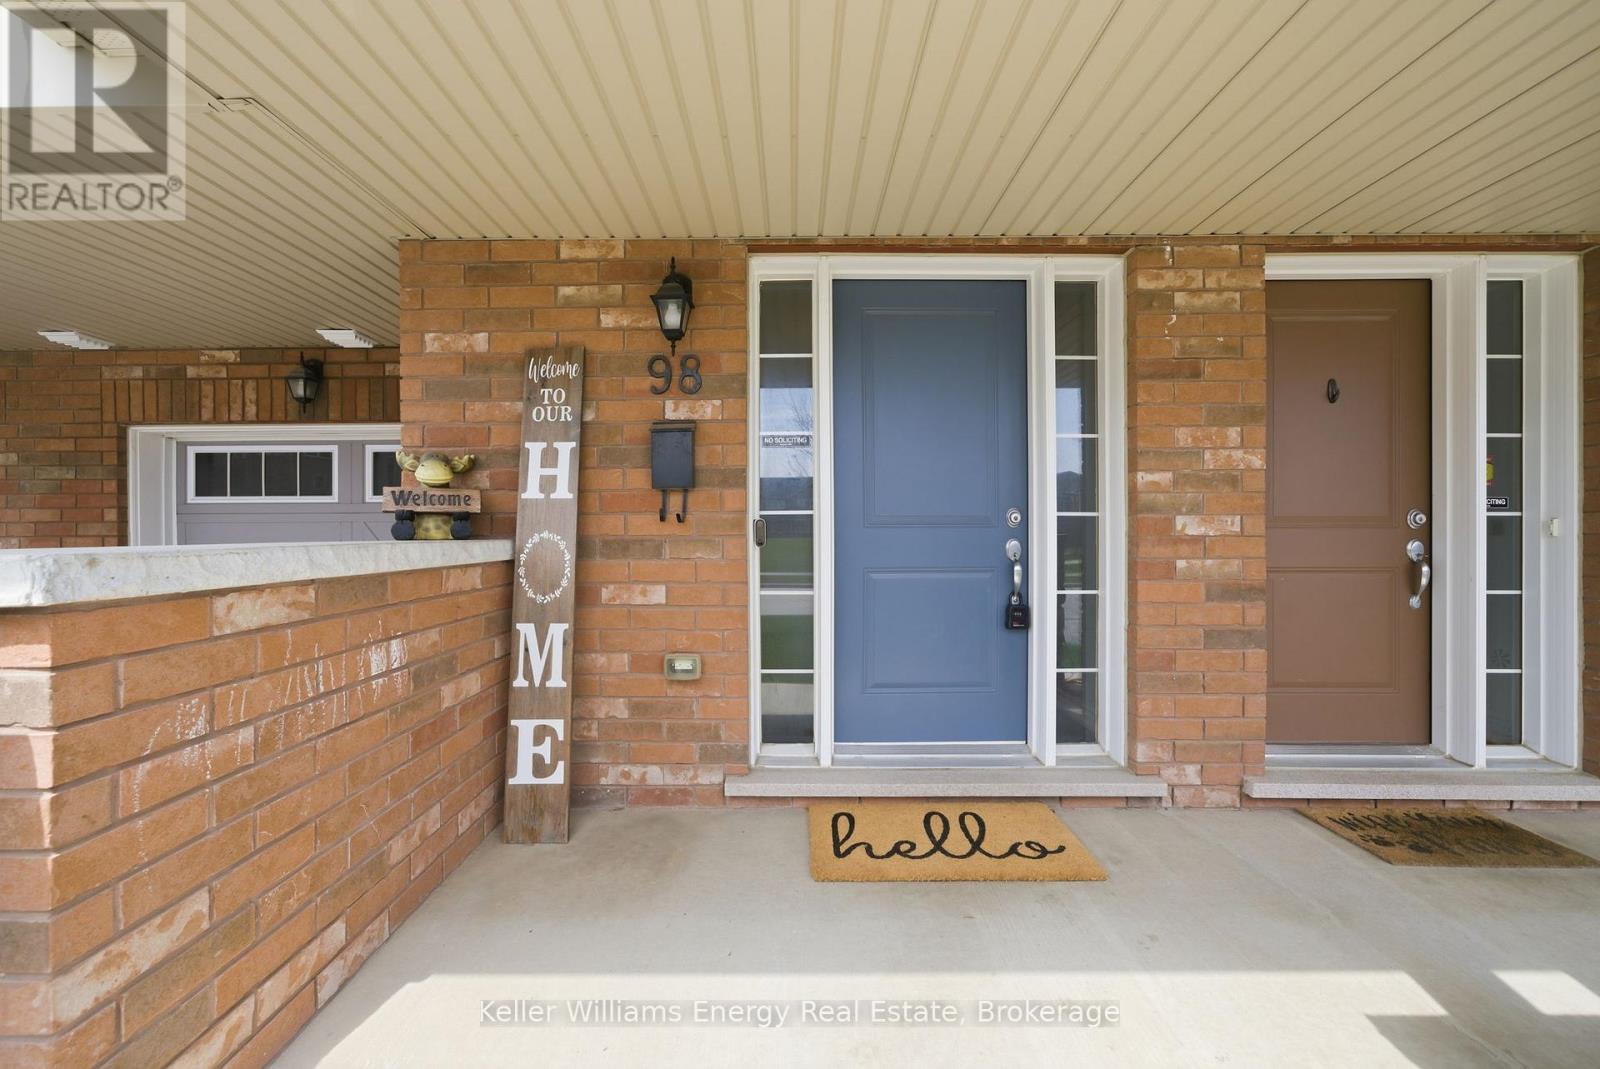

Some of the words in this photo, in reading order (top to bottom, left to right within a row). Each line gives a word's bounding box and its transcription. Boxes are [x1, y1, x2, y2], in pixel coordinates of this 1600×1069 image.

[528, 355, 581, 384] Welcome
[647, 354, 702, 395] 98
[540, 388, 566, 404] TO
[532, 405, 573, 422] OUR
[390, 489, 472, 507] Welcome
[831, 811, 1067, 860] hello
